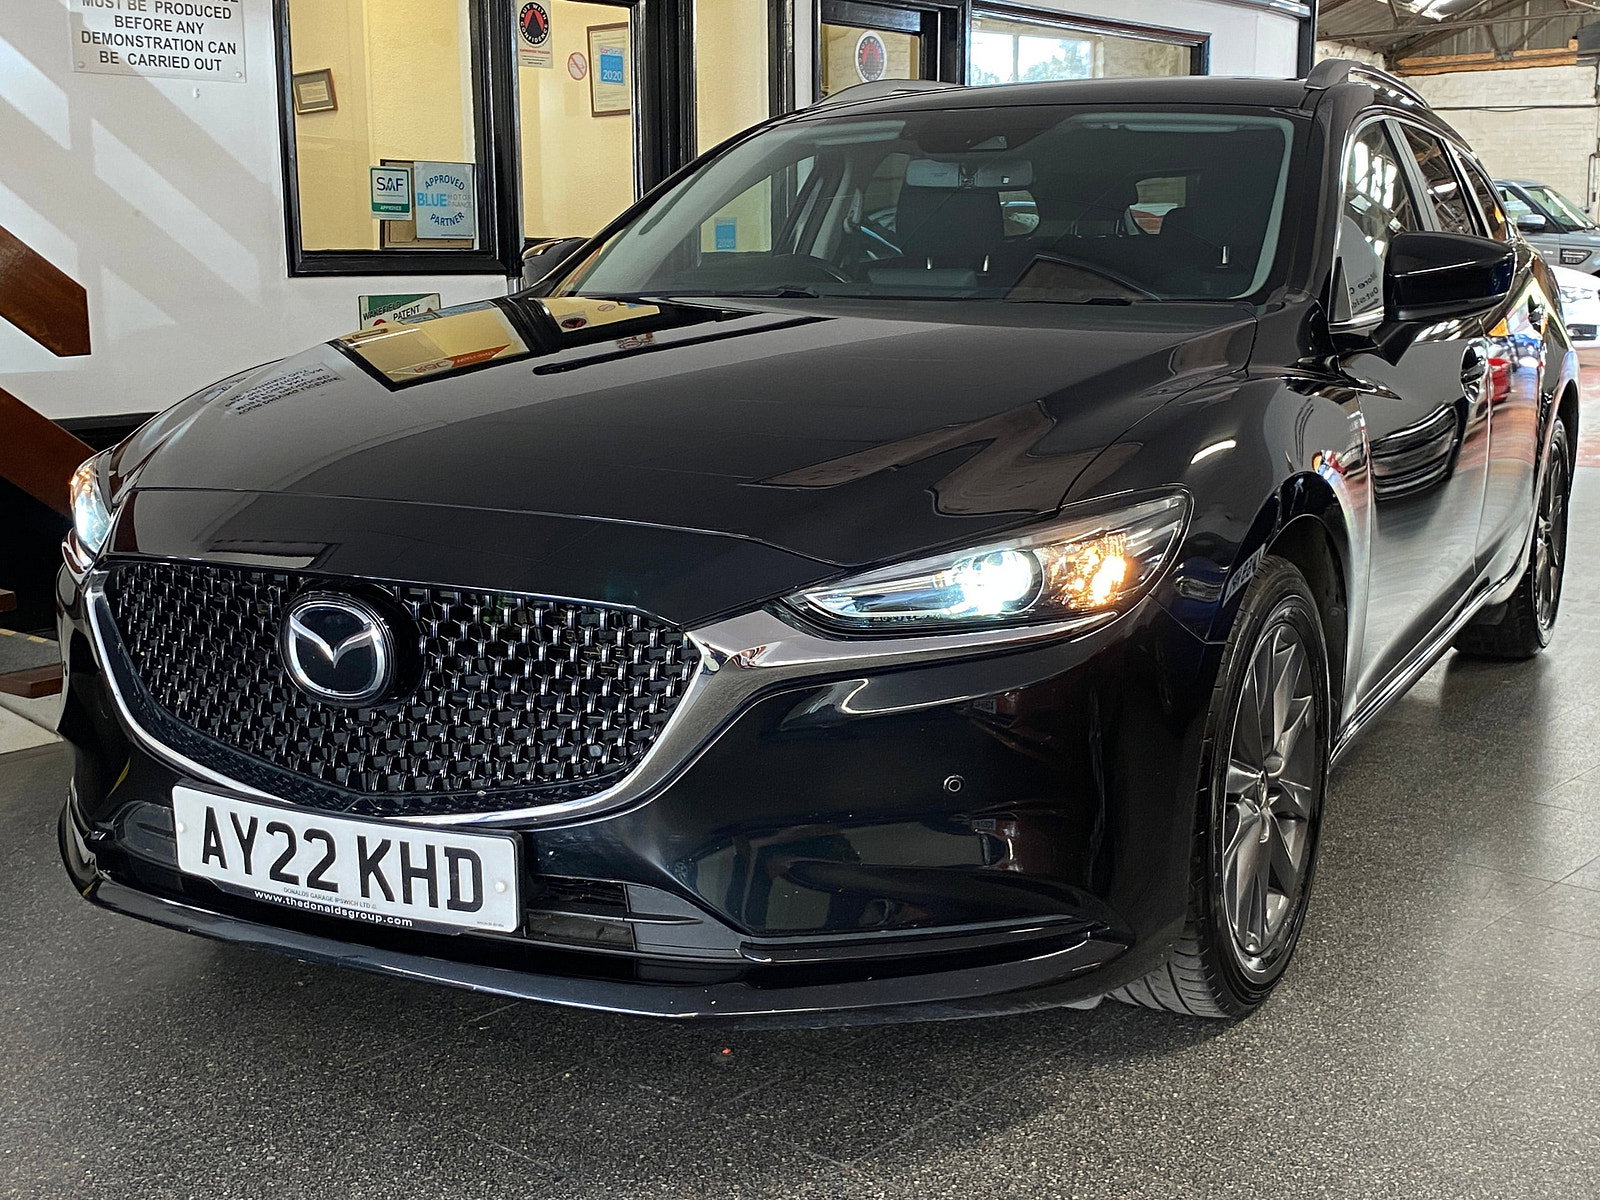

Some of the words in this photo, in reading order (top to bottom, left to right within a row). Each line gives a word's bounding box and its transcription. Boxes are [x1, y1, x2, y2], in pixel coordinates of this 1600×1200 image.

[82, 0, 121, 10] MUST
[128, 0, 147, 12] BE
[155, 1, 232, 19] PRODUCED
[114, 15, 173, 33] BEFORE
[176, 21, 204, 35] ANY
[520, 21, 548, 43] CONFIDENCE
[81, 30, 204, 53] DEMONSTRATION
[207, 41, 237, 55] CAN
[99, 51, 120, 64] BE
[127, 53, 190, 69] CARRIED
[194, 58, 222, 72] OUT
[602, 69, 623, 81] 2020
[376, 176, 404, 191] SAF
[425, 174, 465, 191] APPROVED
[417, 192, 447, 208] BLUE
[430, 211, 465, 226] PARTNER
[393, 304, 421, 320] PATENT
[201, 805, 339, 894] AY22
[356, 834, 483, 913] KHD
[283, 886, 309, 898] DONALDS
[310, 891, 334, 903] GARAGE
[335, 896, 359, 907] IPSWICH
[359, 901, 371, 909] LTD
[254, 889, 413, 927] www.thedonaldsgroup.com
